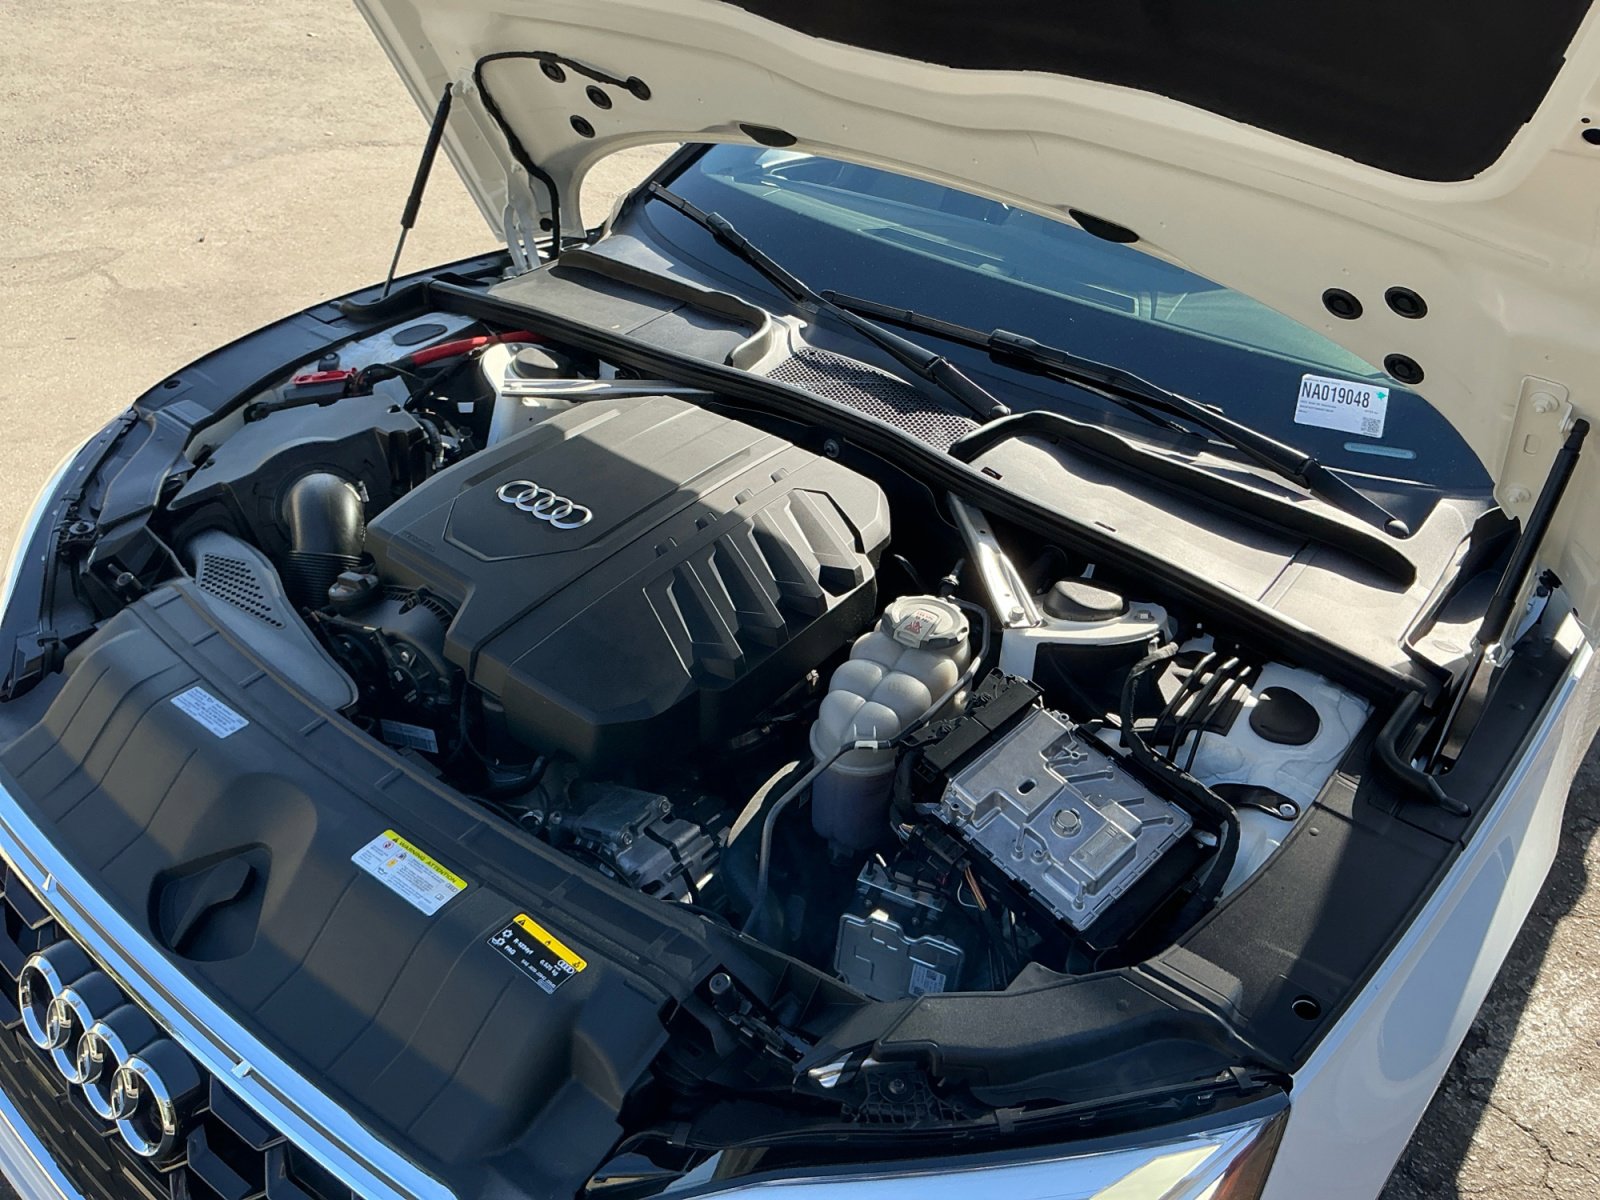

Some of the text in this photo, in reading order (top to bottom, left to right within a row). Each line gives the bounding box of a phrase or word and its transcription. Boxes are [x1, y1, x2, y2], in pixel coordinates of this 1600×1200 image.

[1301, 381, 1371, 409] NA019048
[399, 841, 426, 861] WARNING
[426, 861, 457, 883] ATTENTION
